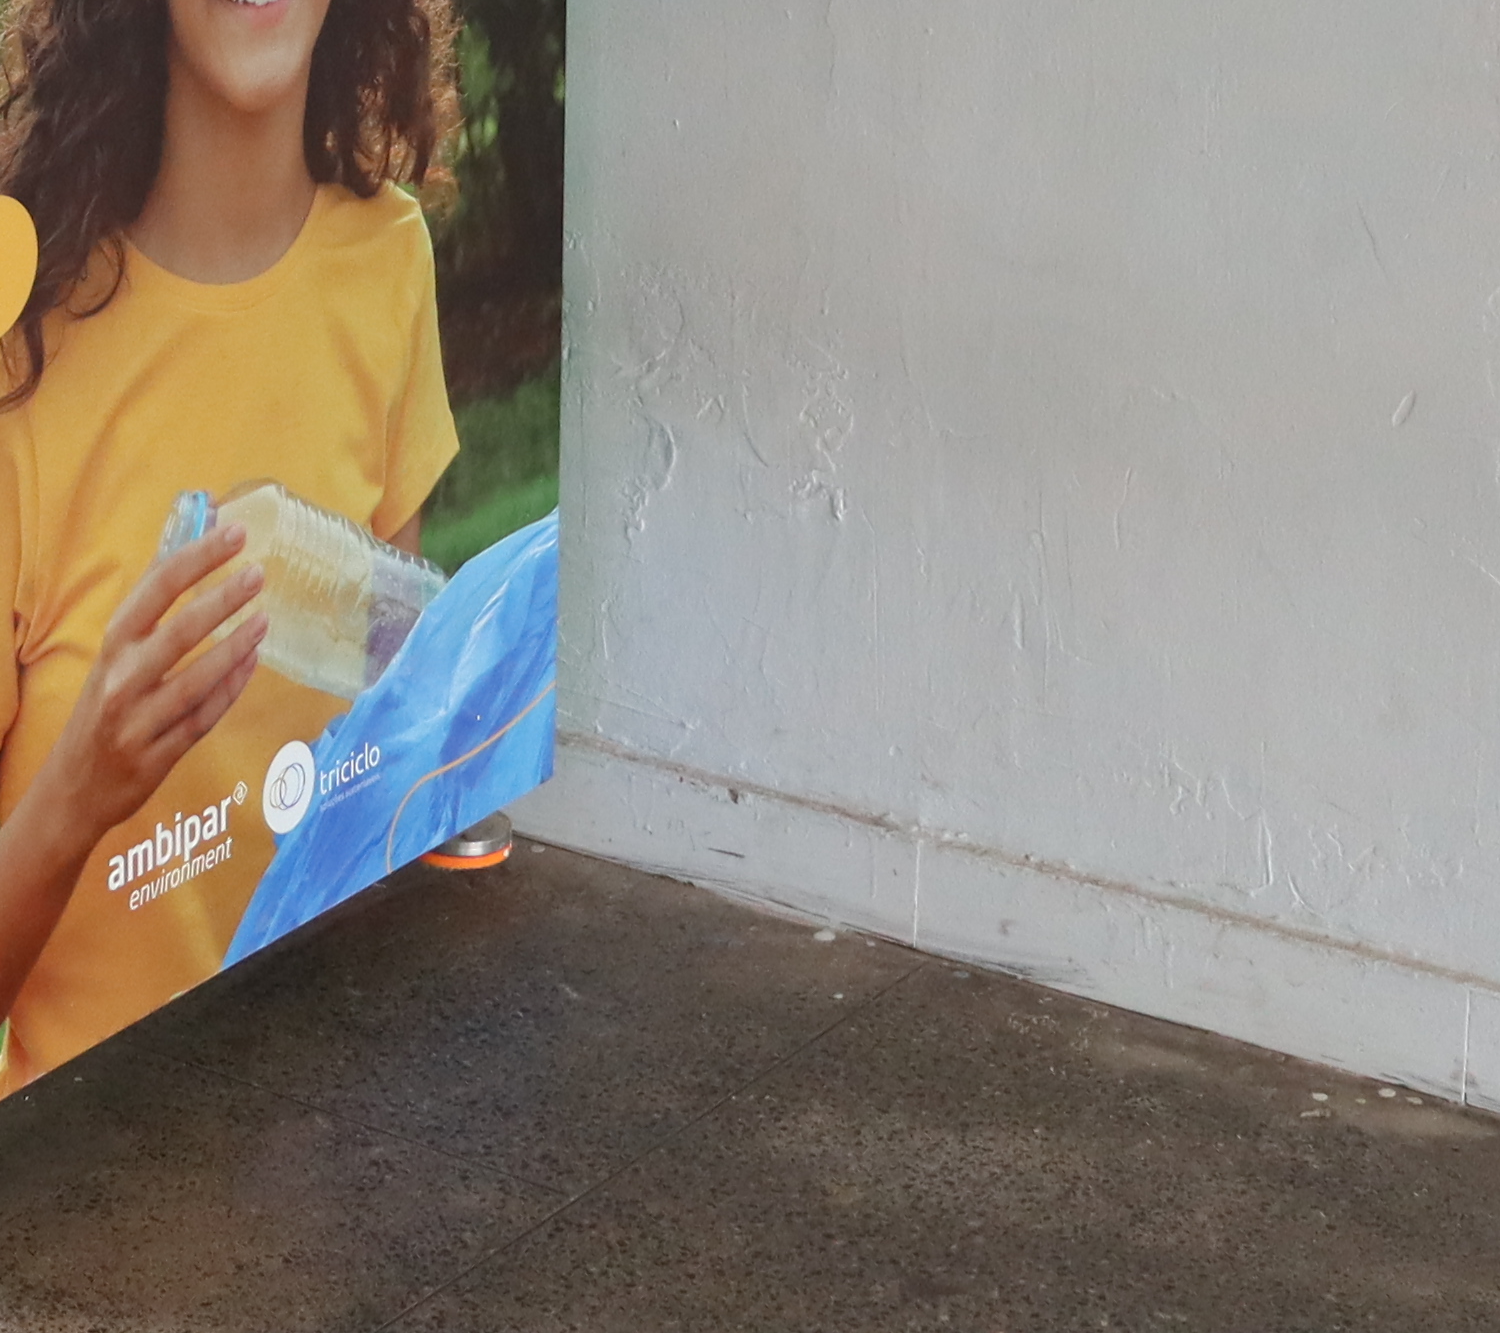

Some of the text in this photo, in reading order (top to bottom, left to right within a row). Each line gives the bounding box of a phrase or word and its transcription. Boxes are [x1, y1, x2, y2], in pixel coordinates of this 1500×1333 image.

[319, 742, 381, 796] triciclo
[107, 796, 232, 891] ambipar
[129, 836, 234, 911] environment
